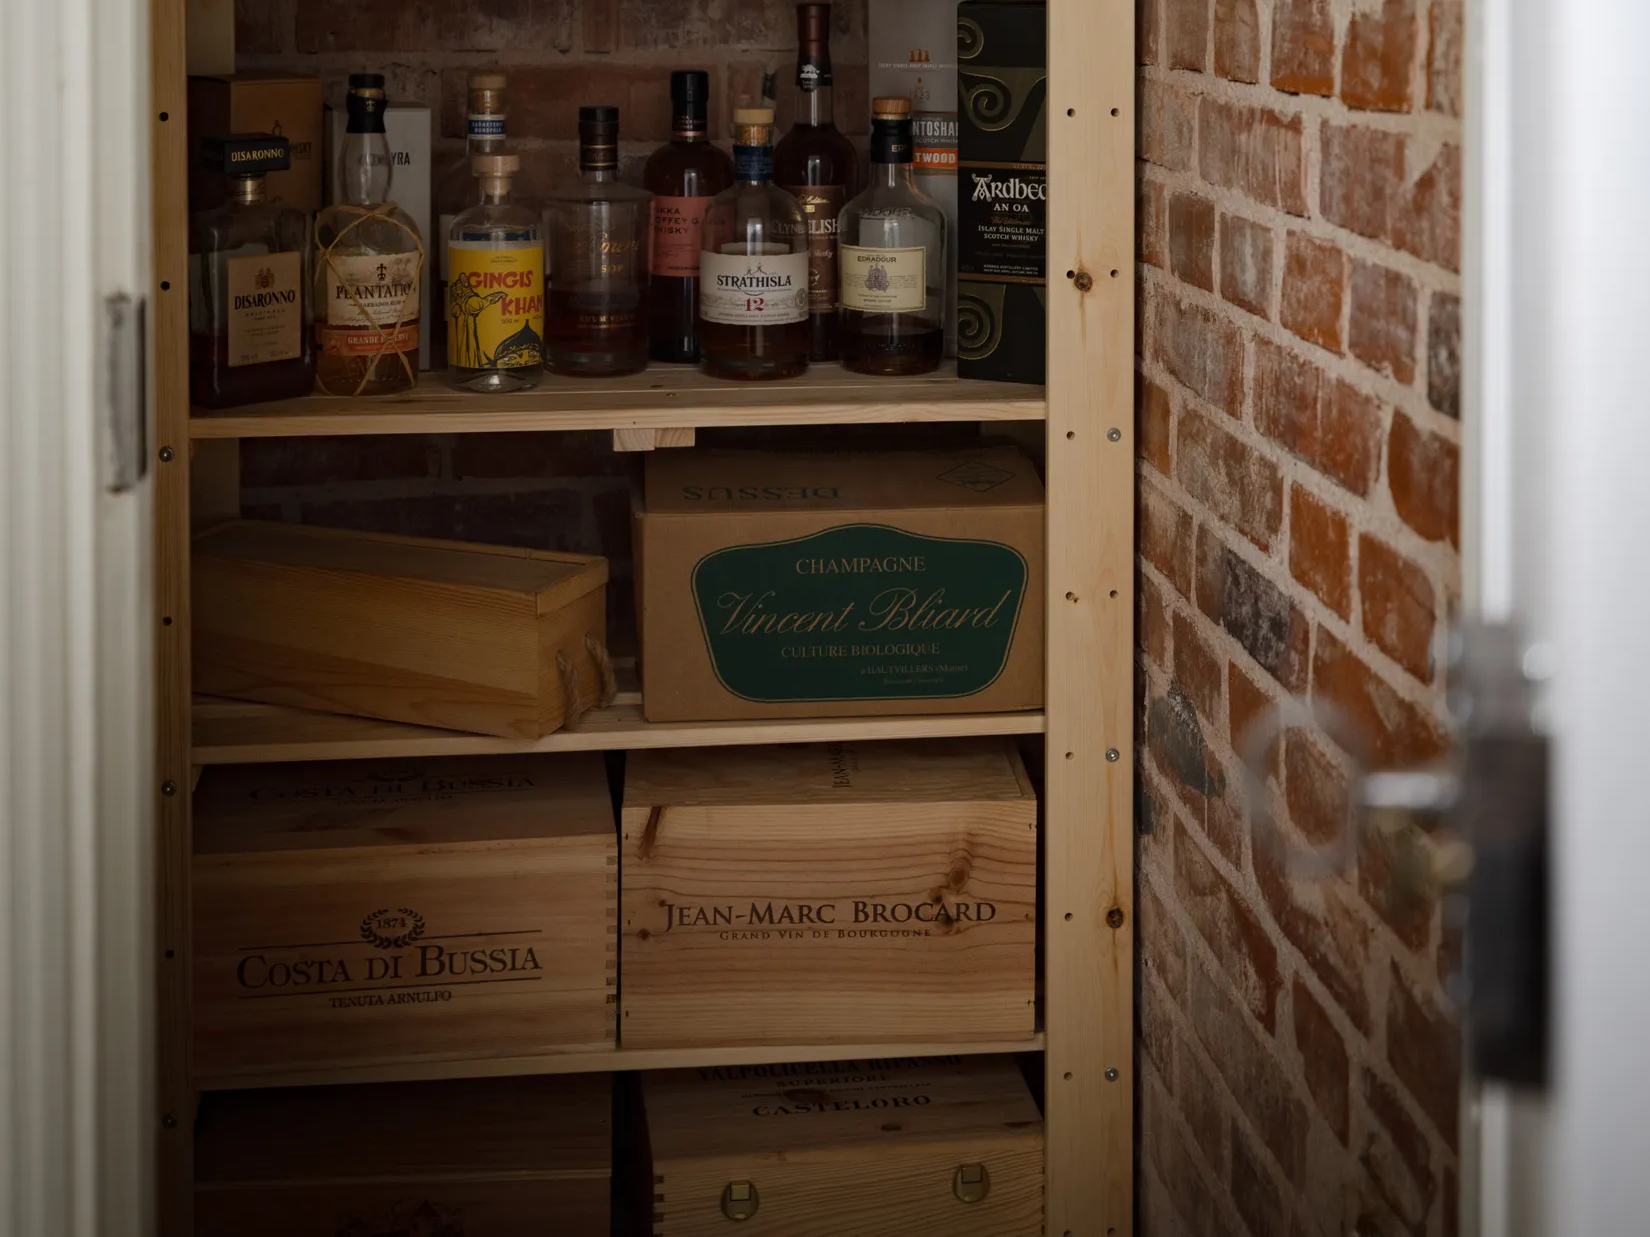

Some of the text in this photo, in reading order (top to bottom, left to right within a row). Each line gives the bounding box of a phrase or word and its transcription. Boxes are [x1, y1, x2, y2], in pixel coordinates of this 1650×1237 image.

[912, 121, 959, 136] NTOSHA
[231, 147, 284, 162] DISARONNO
[291, 141, 312, 154] HISKY
[915, 152, 956, 164] TWOOD
[656, 207, 681, 215] IKKA
[993, 203, 1029, 212] AN OA
[655, 216, 688, 225] OFFEY
[857, 255, 897, 263] EDRADOUR
[469, 269, 534, 288] GINGIS
[716, 274, 792, 289] STRATHISLA
[234, 289, 296, 310] DISARONNO
[501, 293, 543, 316] KHAN
[745, 298, 765, 311] 12
[348, 336, 379, 344] GRANDE
[682, 485, 842, 501] DESSUS
[795, 556, 926, 575] CHAMPAGNE
[716, 587, 1013, 636] Vincent Bliard
[781, 642, 940, 659] CULTURE BIOLOGIQUE
[375, 918, 407, 929] 1874
[664, 900, 997, 932] JEAN-MARC BROCARD
[719, 929, 931, 941] GRAND VIN DE BOURGOGNE
[237, 944, 543, 989] COSTA DI BUSSIA
[329, 990, 452, 1009] TENUTA ARNULFO
[752, 1095, 932, 1118] CASTELORO
